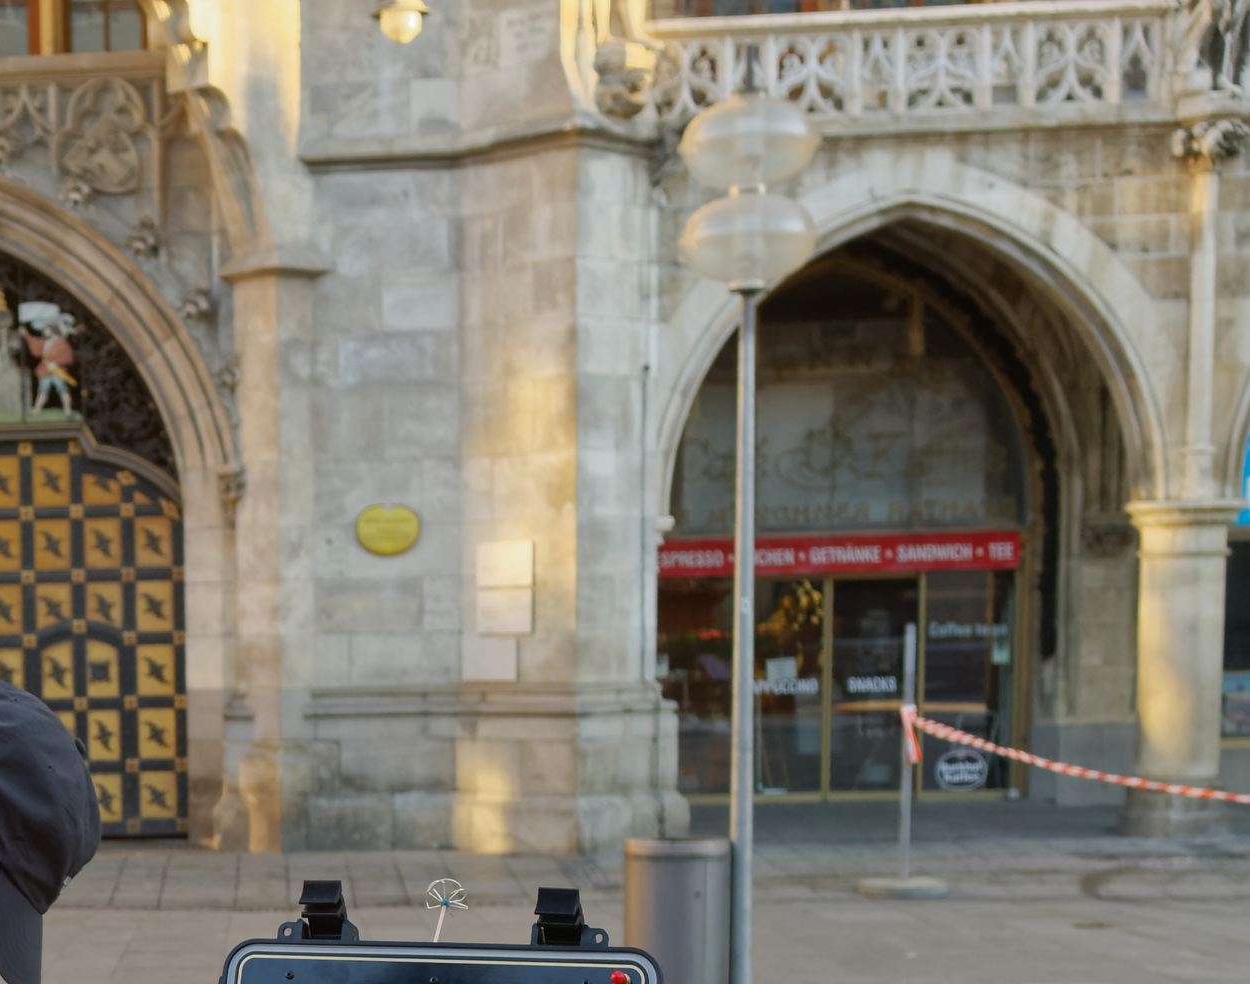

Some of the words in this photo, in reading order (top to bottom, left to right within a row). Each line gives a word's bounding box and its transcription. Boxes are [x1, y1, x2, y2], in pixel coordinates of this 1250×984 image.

[810, 543, 882, 565] GETRÄNKE
[896, 543, 973, 562] SANDWICH
[988, 541, 1016, 561] TEE
[847, 676, 898, 693] SNACKS
